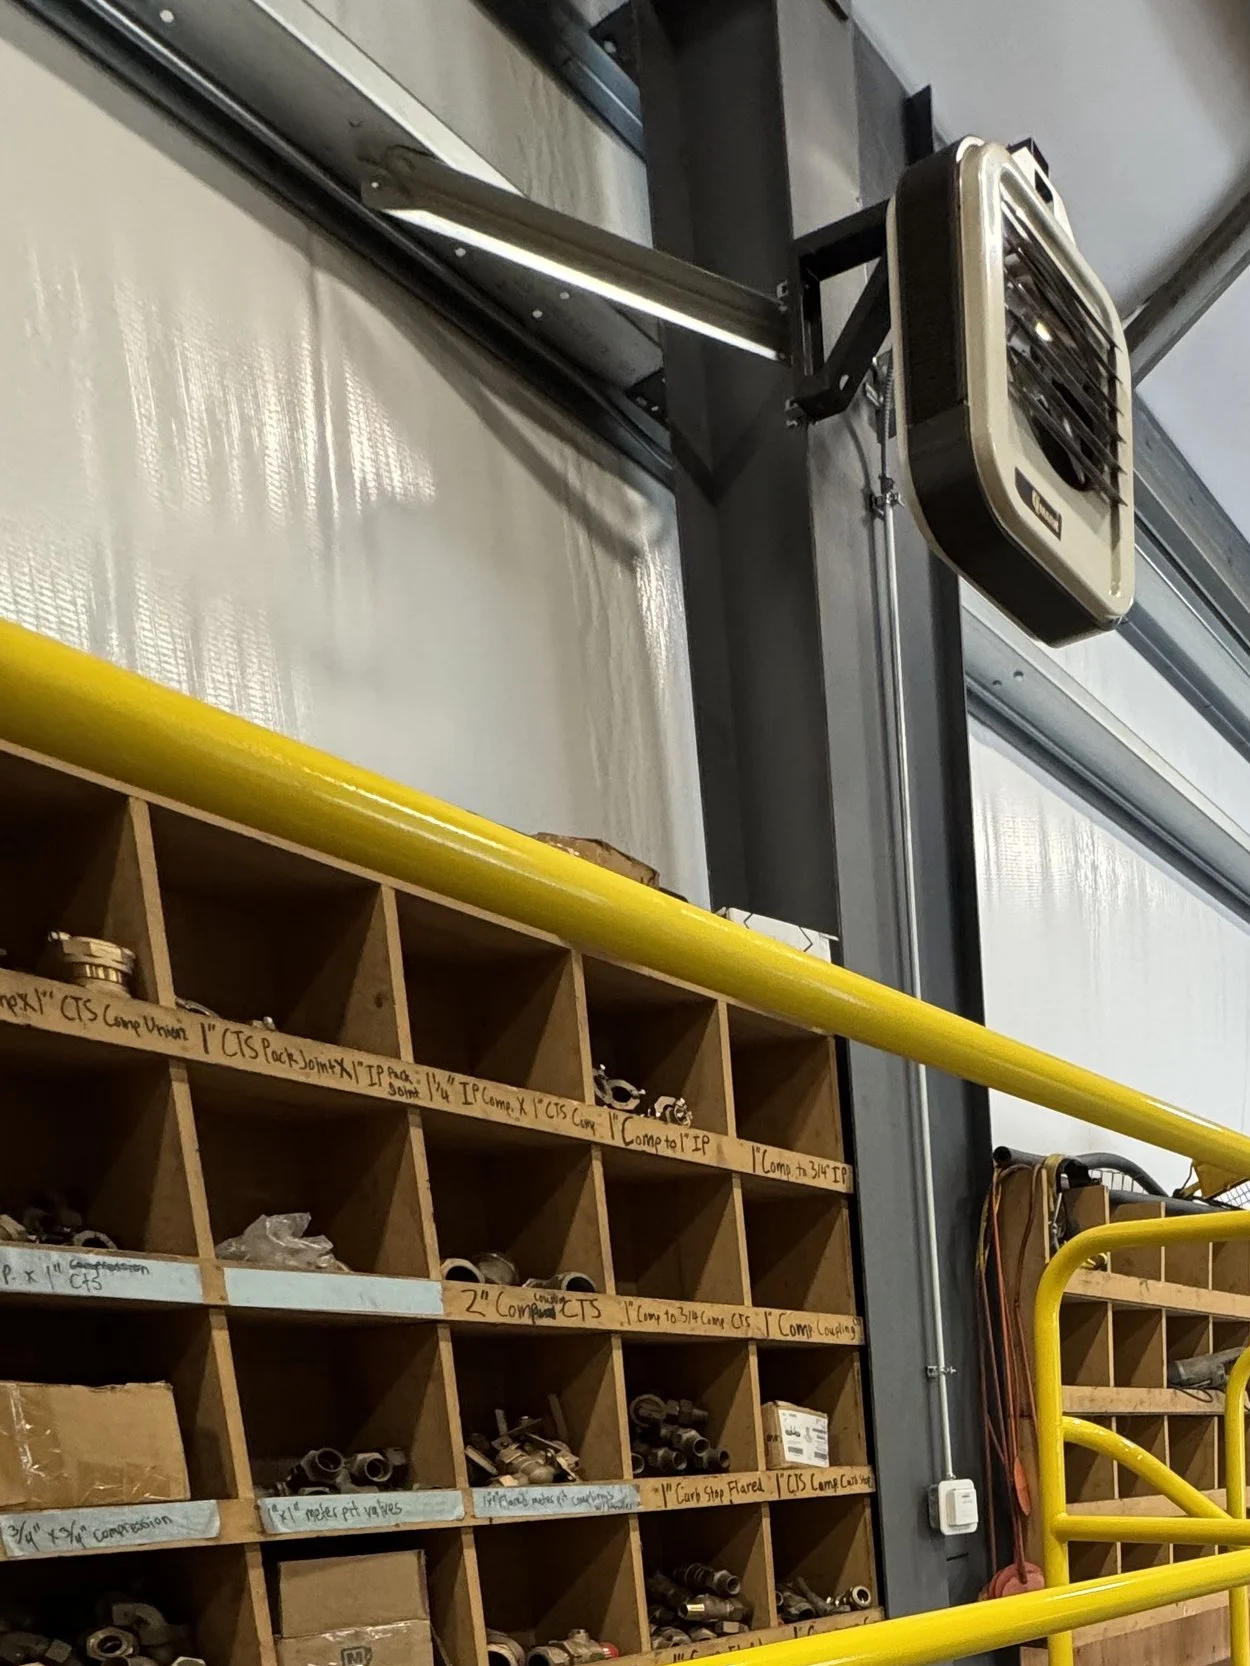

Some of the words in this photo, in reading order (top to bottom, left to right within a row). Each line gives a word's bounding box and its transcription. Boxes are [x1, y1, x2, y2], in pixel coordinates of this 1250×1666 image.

[61, 995, 98, 1022] CTS
[103, 1004, 141, 1037] Comp
[144, 1016, 189, 1041] Union
[200, 1022, 216, 1055] 1"
[222, 1028, 259, 1060] CTS
[261, 1037, 298, 1068] Pack
[299, 1050, 335, 1076] Joint
[352, 1062, 364, 1084] 1"
[364, 1065, 384, 1087] IP
[459, 1082, 479, 1105] IP
[516, 1097, 527, 1116] X
[545, 1101, 568, 1120] CTS
[608, 1112, 619, 1141] 1"
[621, 1116, 662, 1153] Comp
[664, 1135, 677, 1152] to
[679, 1133, 689, 1153] 1"
[691, 1135, 710, 1156] IP
[751, 1145, 761, 1173] 1"
[796, 1165, 808, 1178] to
[831, 1166, 848, 1186] IP
[46, 1262, 62, 1291] 1"
[461, 1289, 489, 1317] 2"
[560, 1298, 602, 1321] CTS
[624, 1300, 634, 1326] 1"
[664, 1310, 677, 1323] to
[731, 1315, 751, 1331] CTS
[763, 1311, 772, 1337] 1"
[661, 1483, 672, 1508] 1"
[704, 1485, 725, 1503] Stop
[729, 1480, 764, 1497] Flared
[776, 1473, 785, 1498] 1"
[787, 1473, 807, 1493] CTS
[305, 1503, 339, 1522] meter
[341, 1501, 360, 1523] pit
[364, 1499, 403, 1518] valves
[8, 1519, 41, 1552] 3/4"
[58, 1519, 88, 1550] 3/4"
